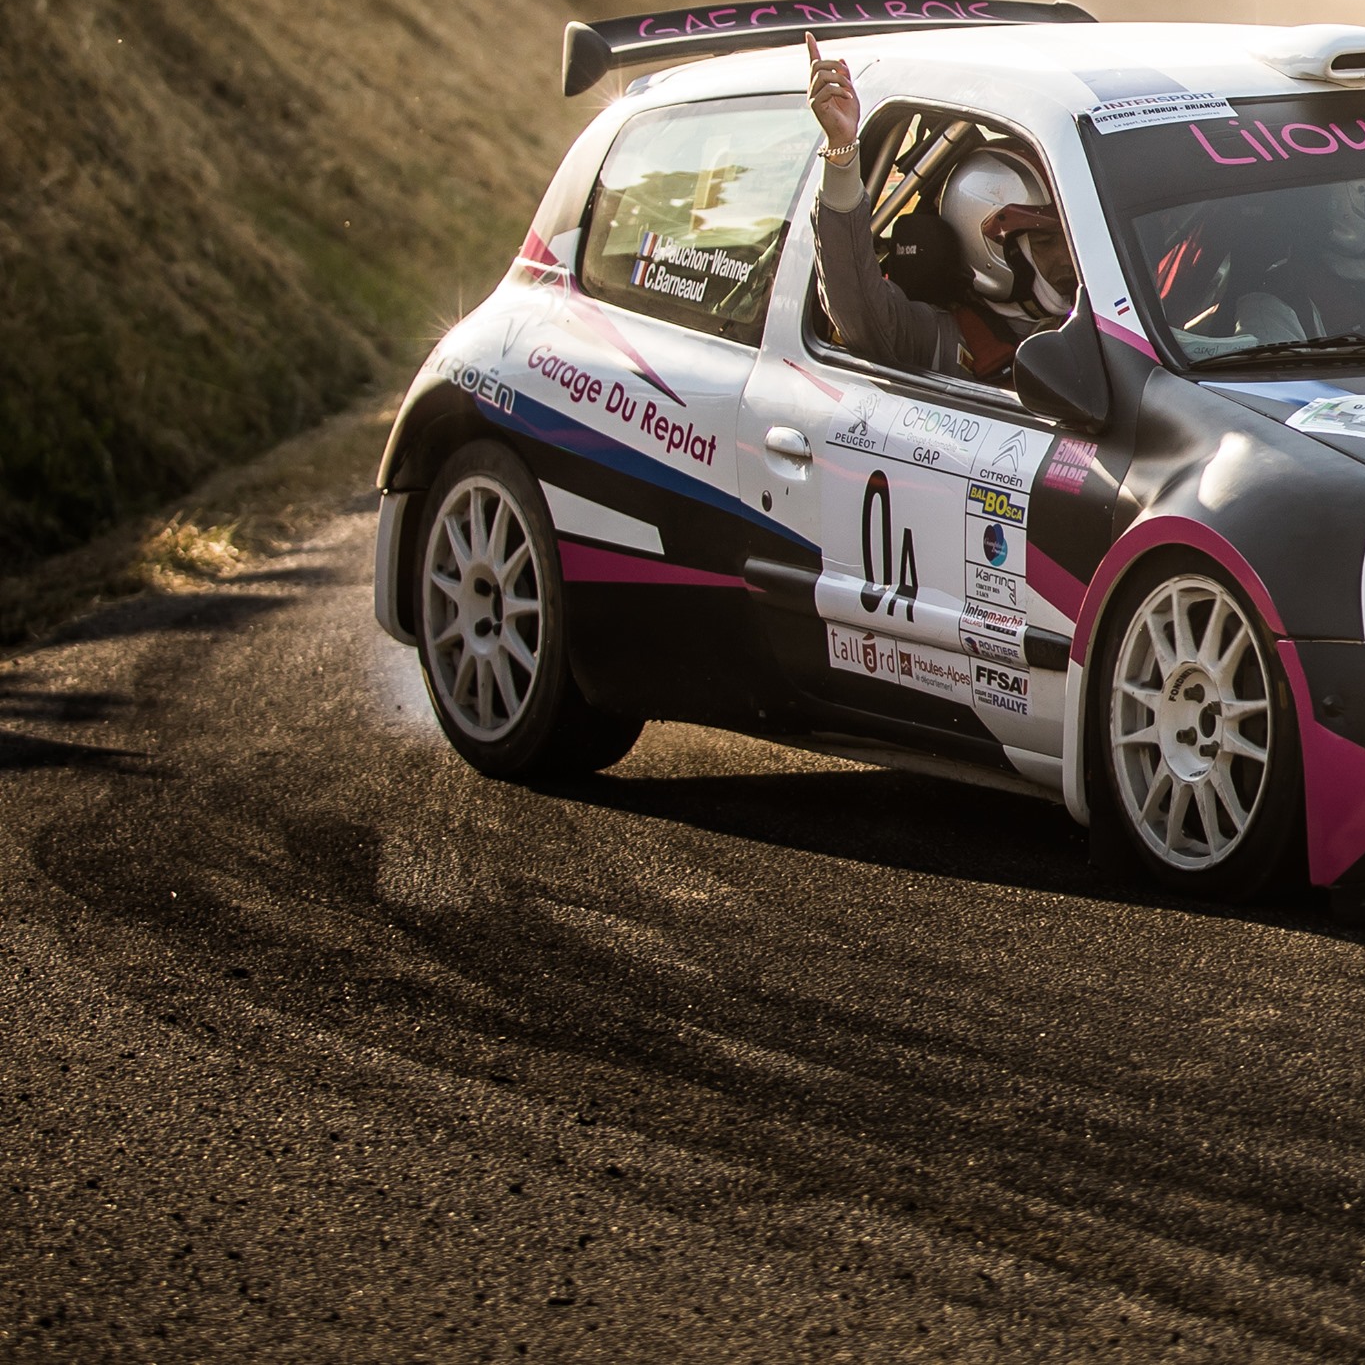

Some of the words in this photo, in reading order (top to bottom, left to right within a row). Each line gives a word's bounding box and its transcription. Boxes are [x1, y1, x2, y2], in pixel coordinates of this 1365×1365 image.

[1095, 111, 1136, 123] SISTERON
[1143, 105, 1178, 116] EMBRUN
[1185, 101, 1228, 112] BRIANÇON
[1103, 92, 1215, 110] INTERSPORT
[644, 264, 709, 302] C.Barneaud
[527, 344, 603, 403] Garage
[605, 381, 637, 422] Du
[640, 400, 717, 466] Replat
[902, 406, 980, 442] CHOPARD
[834, 432, 877, 450] PEUGEOT
[1052, 437, 1098, 468] EMMA
[912, 447, 941, 465] GAP
[965, 602, 1023, 626] Intermarché
[913, 654, 971, 686] Hautes-Alpes
[976, 665, 1023, 696] FFSA
[993, 694, 1027, 715] RALLYE
